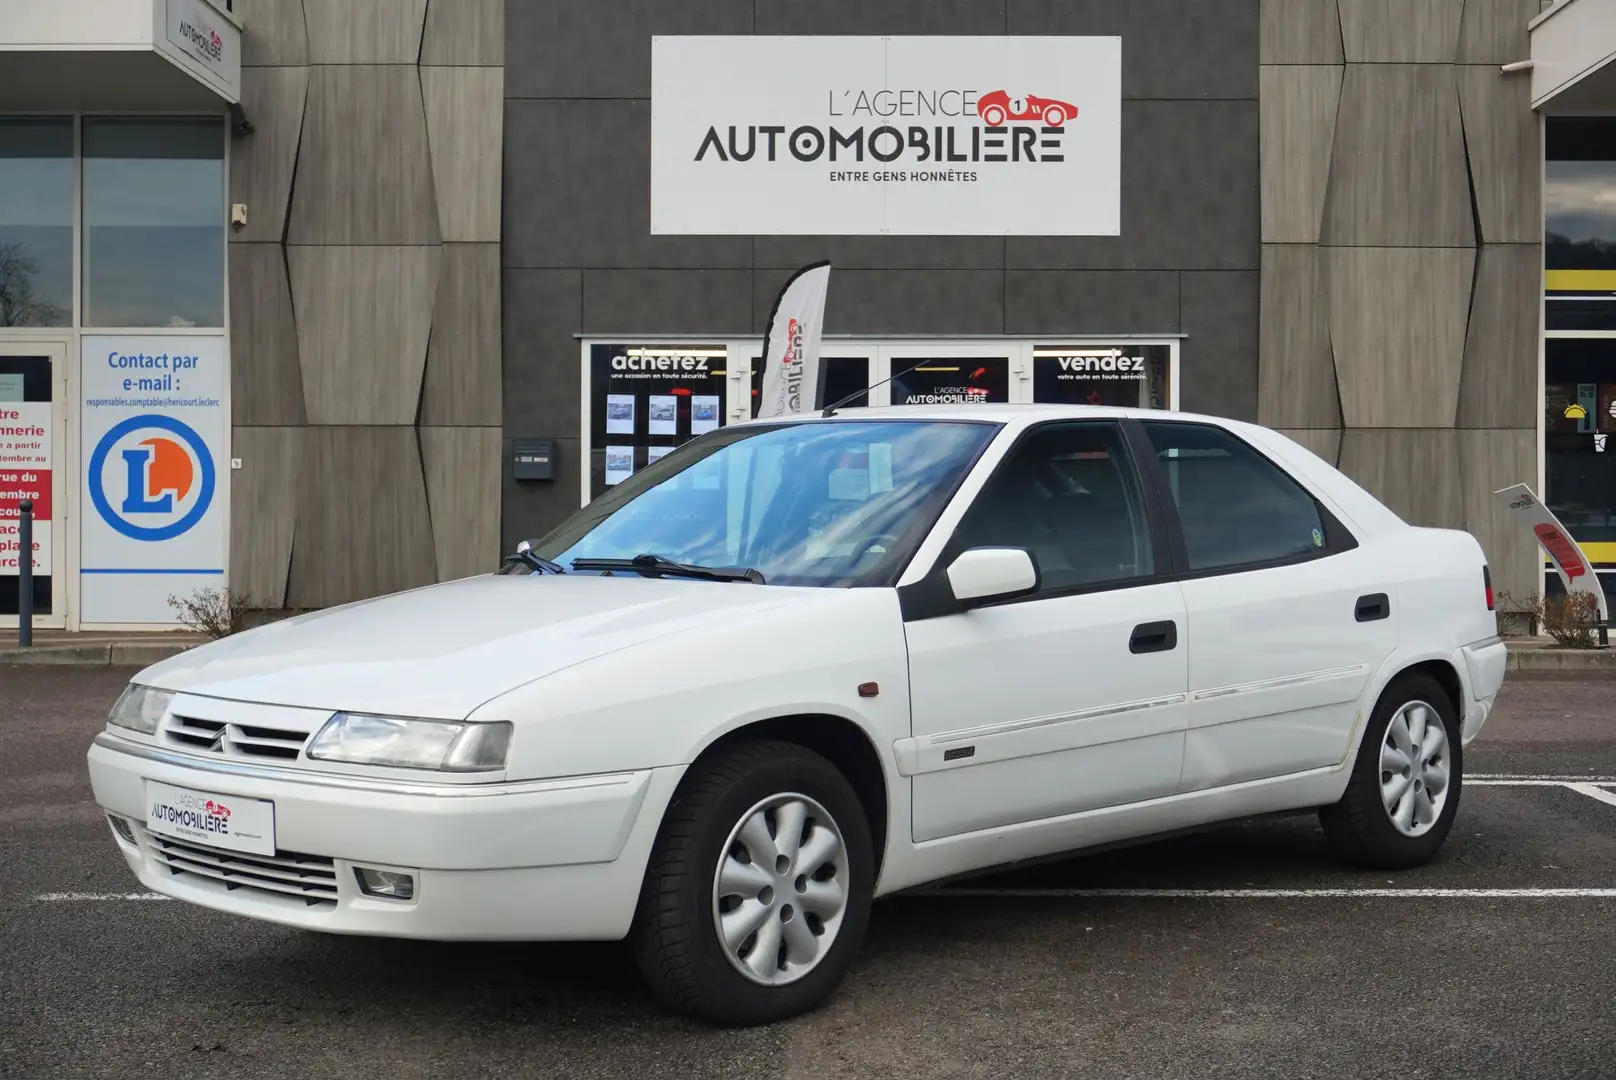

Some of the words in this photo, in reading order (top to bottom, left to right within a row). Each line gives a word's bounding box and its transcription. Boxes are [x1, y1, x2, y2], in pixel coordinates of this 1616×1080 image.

[829, 90, 978, 116] L'AGENCE
[830, 172, 869, 182] ENTRE
[873, 172, 907, 182] GENS
[910, 169, 977, 182] HONNÊTES
[108, 351, 169, 368] Contact
[172, 355, 198, 372] par
[611, 347, 708, 370] achetez
[1057, 348, 1145, 371] vendez
[123, 374, 171, 391] e-mail
[934, 386, 968, 394] L'AGENCE
[15, 441, 41, 450] partir
[21, 472, 37, 482] du
[0, 539, 40, 553] plae
